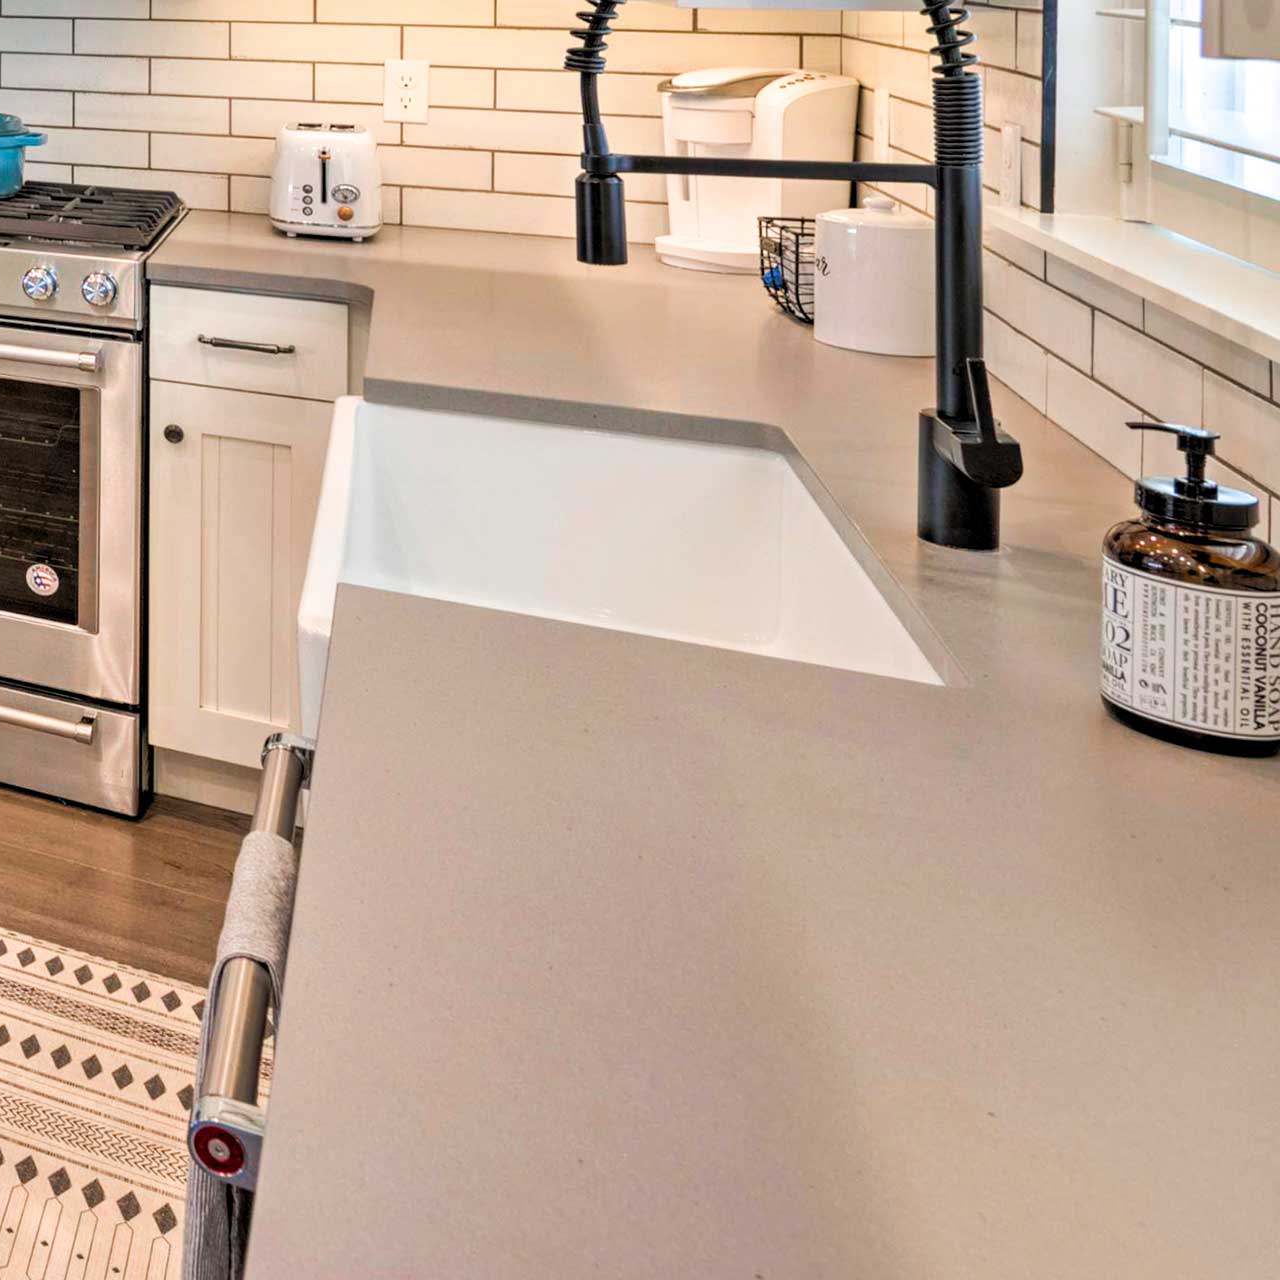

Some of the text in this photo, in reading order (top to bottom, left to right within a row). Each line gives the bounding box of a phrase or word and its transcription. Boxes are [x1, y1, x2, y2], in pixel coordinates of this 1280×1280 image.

[1240, 602, 1252, 727] WITH ESSENTIAL OIL
[1254, 602, 1268, 731] COCONUT VANILLA
